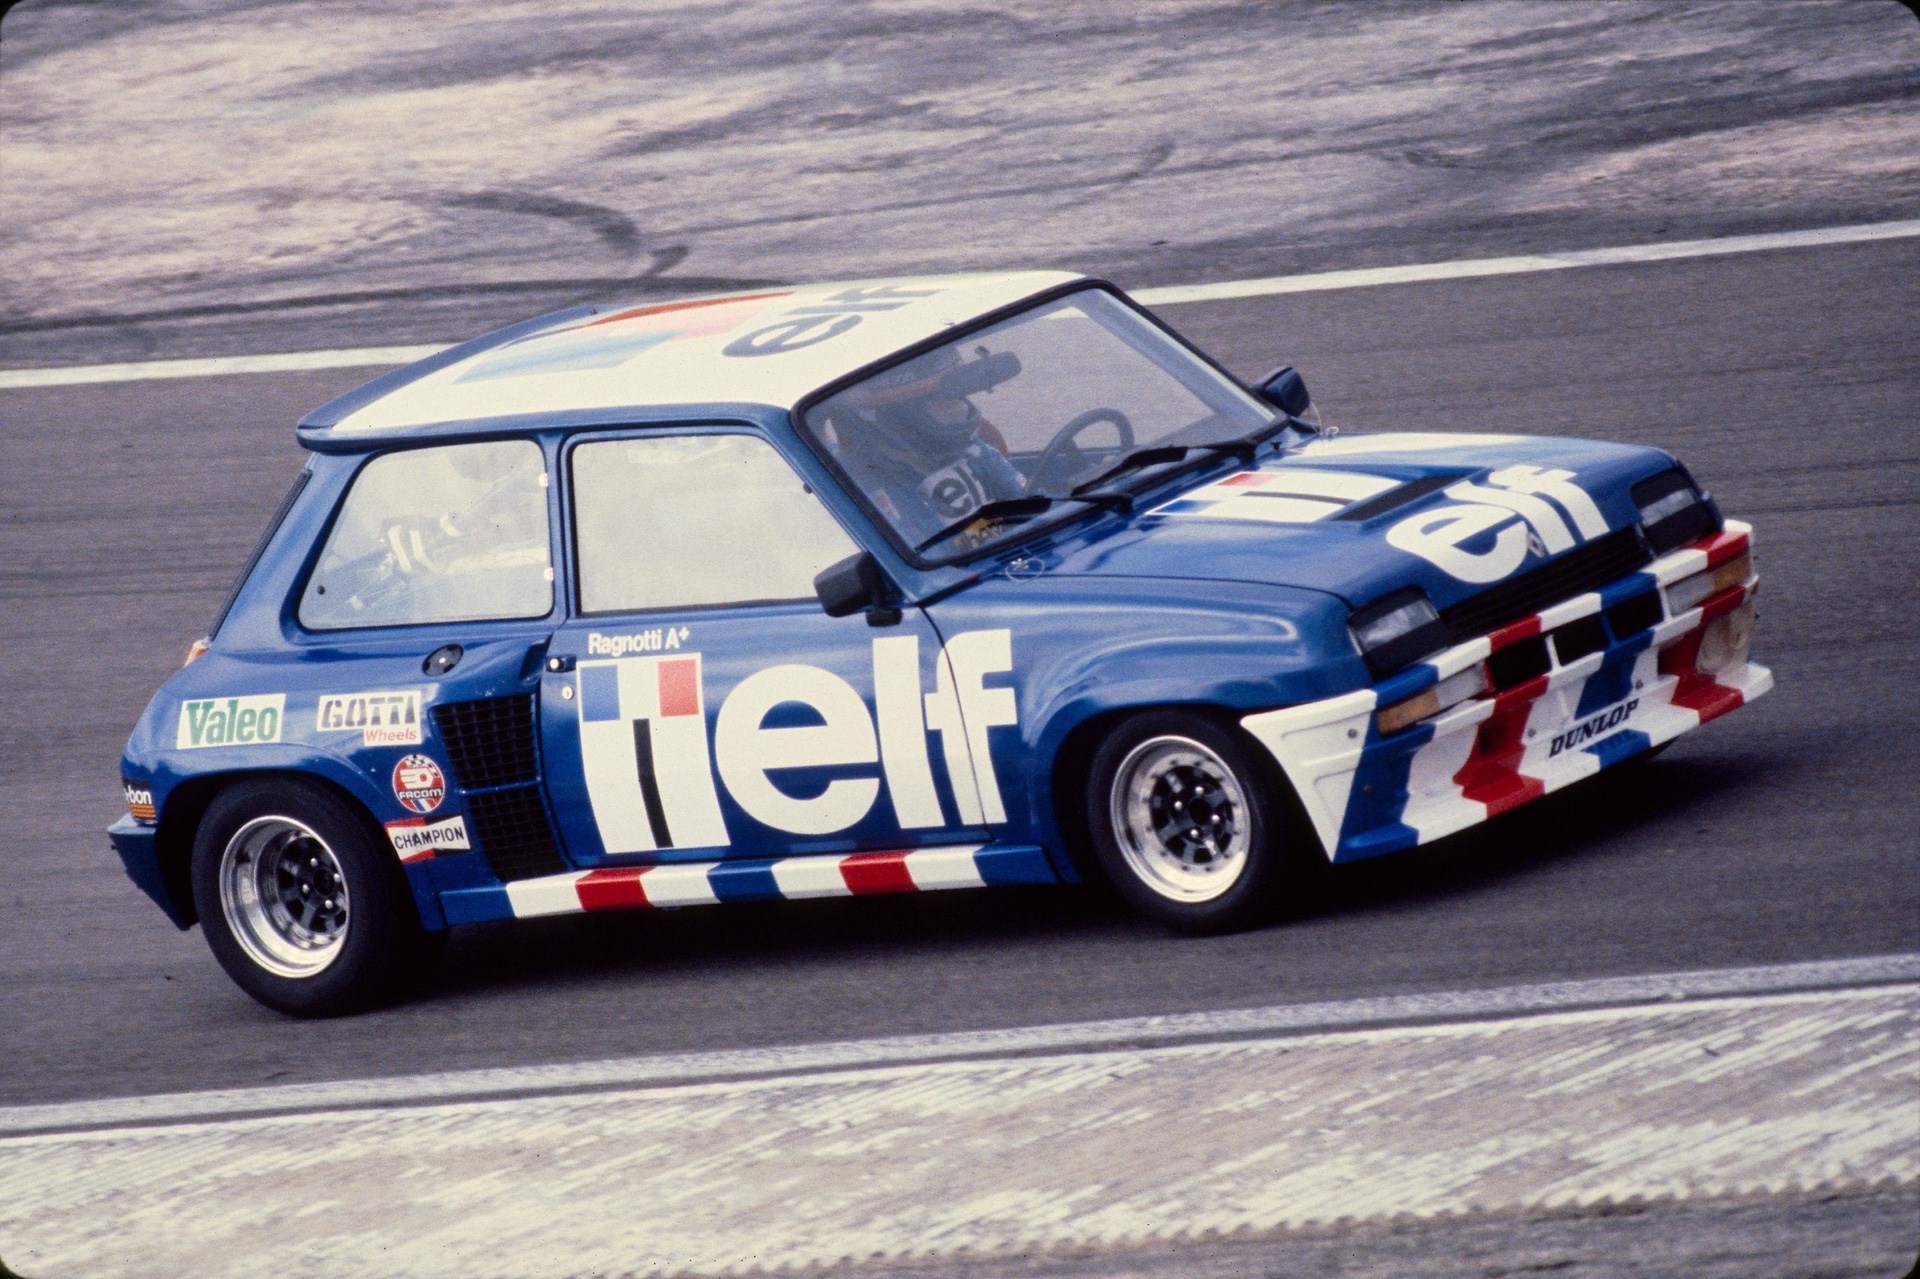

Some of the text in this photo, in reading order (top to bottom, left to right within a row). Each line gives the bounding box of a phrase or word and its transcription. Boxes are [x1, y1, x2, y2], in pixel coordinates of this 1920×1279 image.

[722, 285, 947, 357] elf
[1386, 464, 1611, 584] elf
[588, 626, 690, 657] Ragnotti A+
[186, 699, 279, 746] Valeo
[321, 695, 416, 729] GOTTI
[365, 728, 417, 743] Wheels
[715, 628, 1018, 836] elf
[1548, 698, 1640, 759] DUNLOP
[393, 826, 466, 850] CHAMPION
